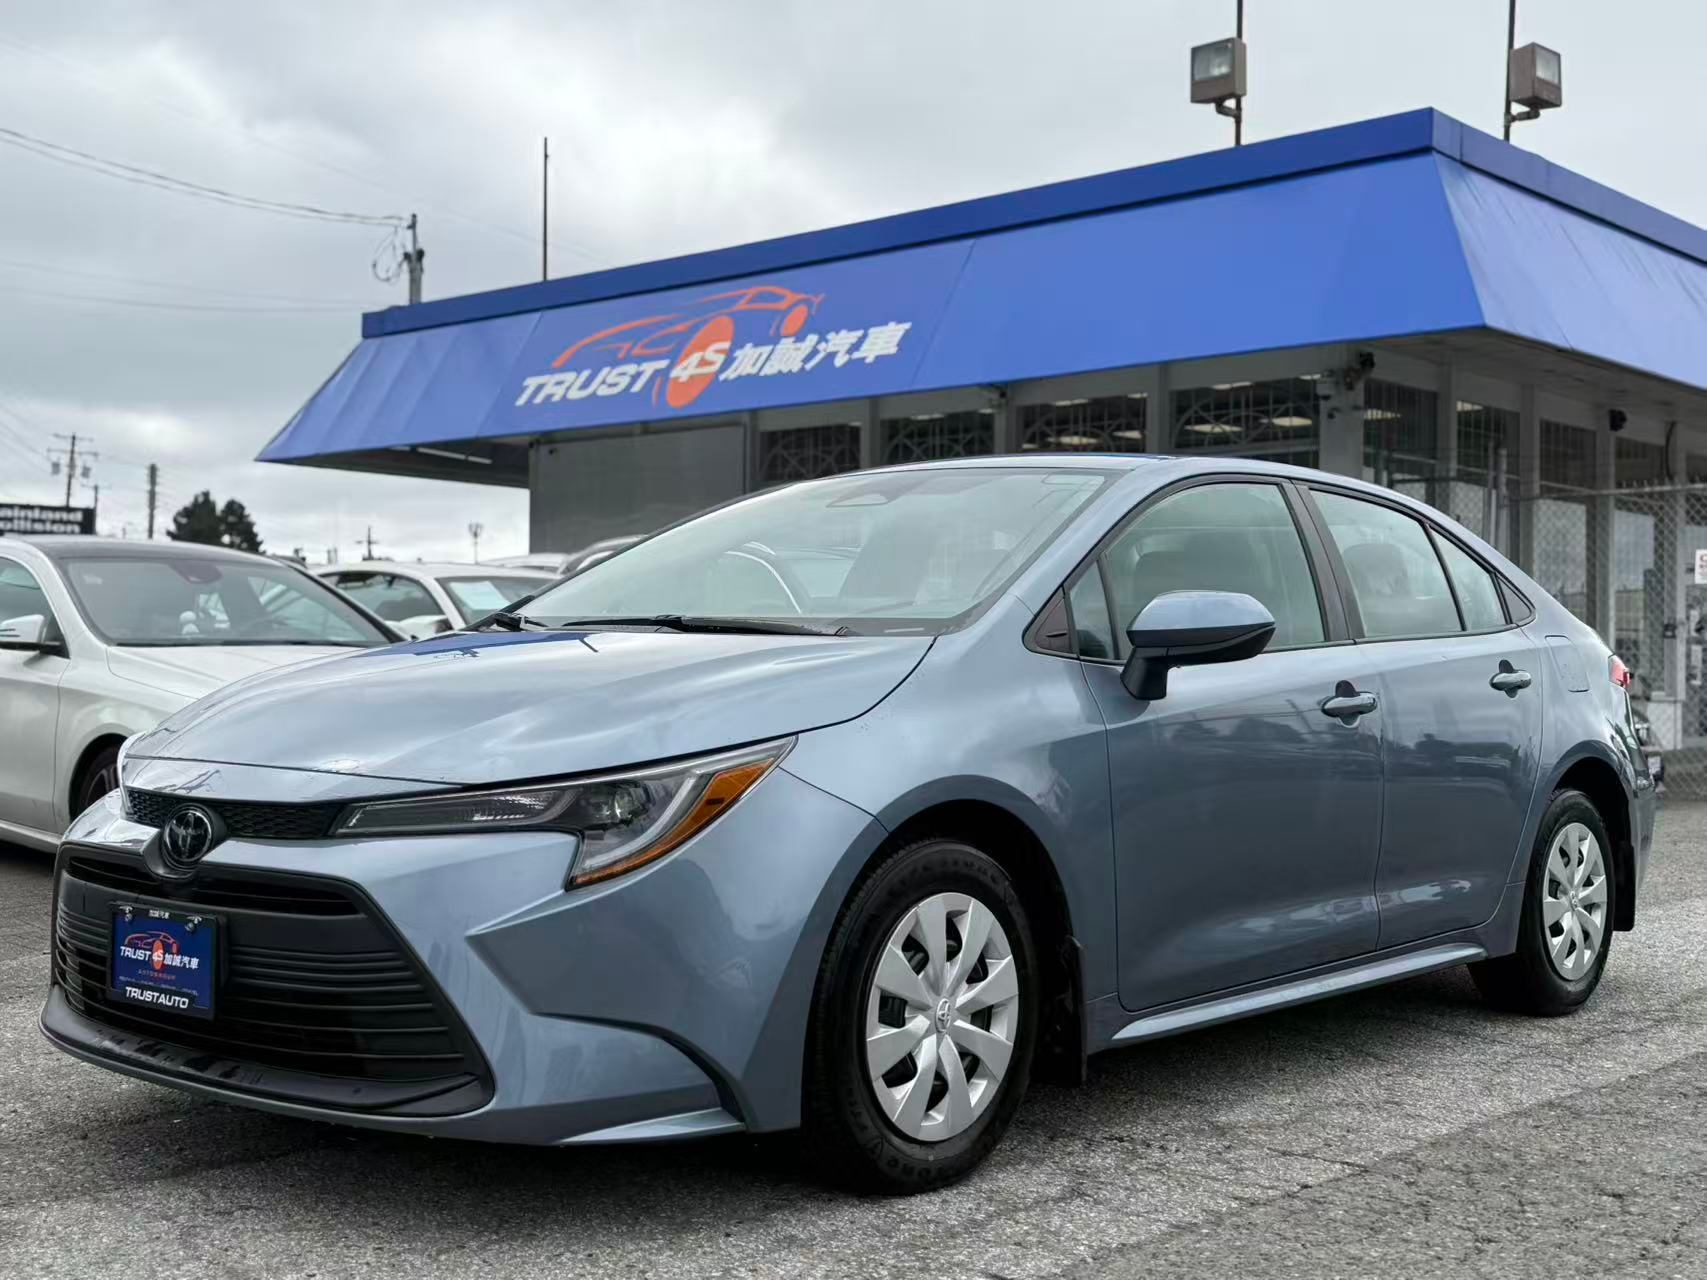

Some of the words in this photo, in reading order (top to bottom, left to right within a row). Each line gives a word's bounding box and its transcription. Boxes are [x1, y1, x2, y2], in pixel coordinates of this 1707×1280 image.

[515, 359, 670, 406] TRUST
[669, 342, 732, 383] 4S
[718, 321, 912, 382] 加誠汽車
[120, 946, 151, 961] TRUST
[125, 986, 189, 1009] TRUSTAUTO
